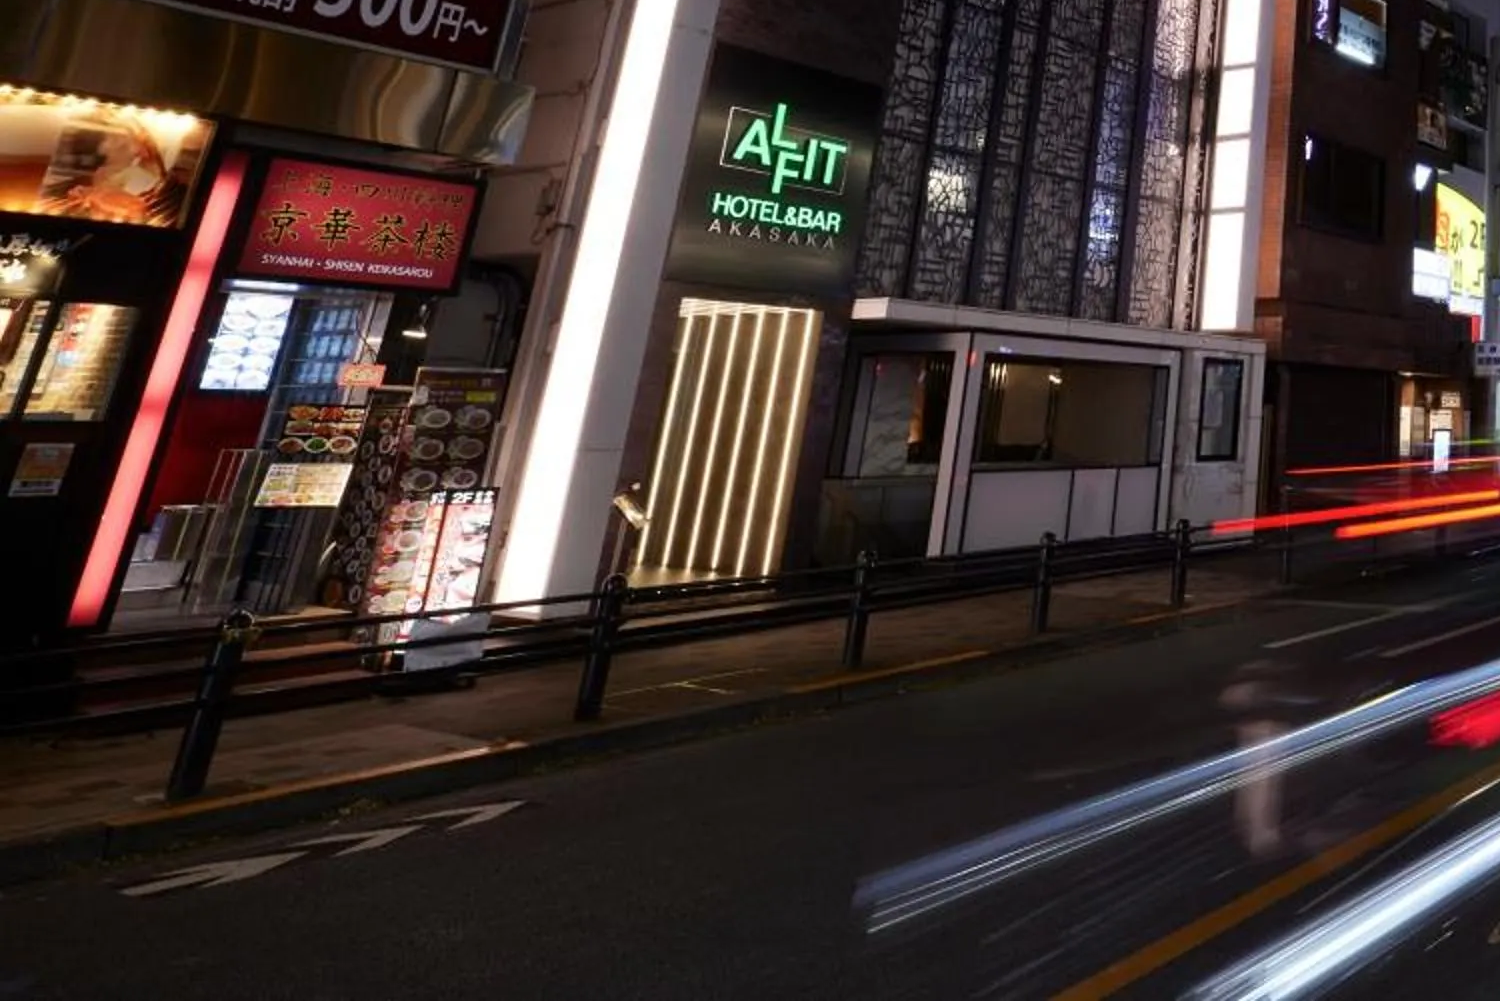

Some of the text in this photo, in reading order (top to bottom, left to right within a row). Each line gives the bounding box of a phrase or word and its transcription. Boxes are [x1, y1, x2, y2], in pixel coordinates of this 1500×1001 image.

[260, 202, 457, 262] 京華茶楼
[707, 218, 836, 250] AKASAKA
[710, 192, 842, 234] HOTEL&BAR
